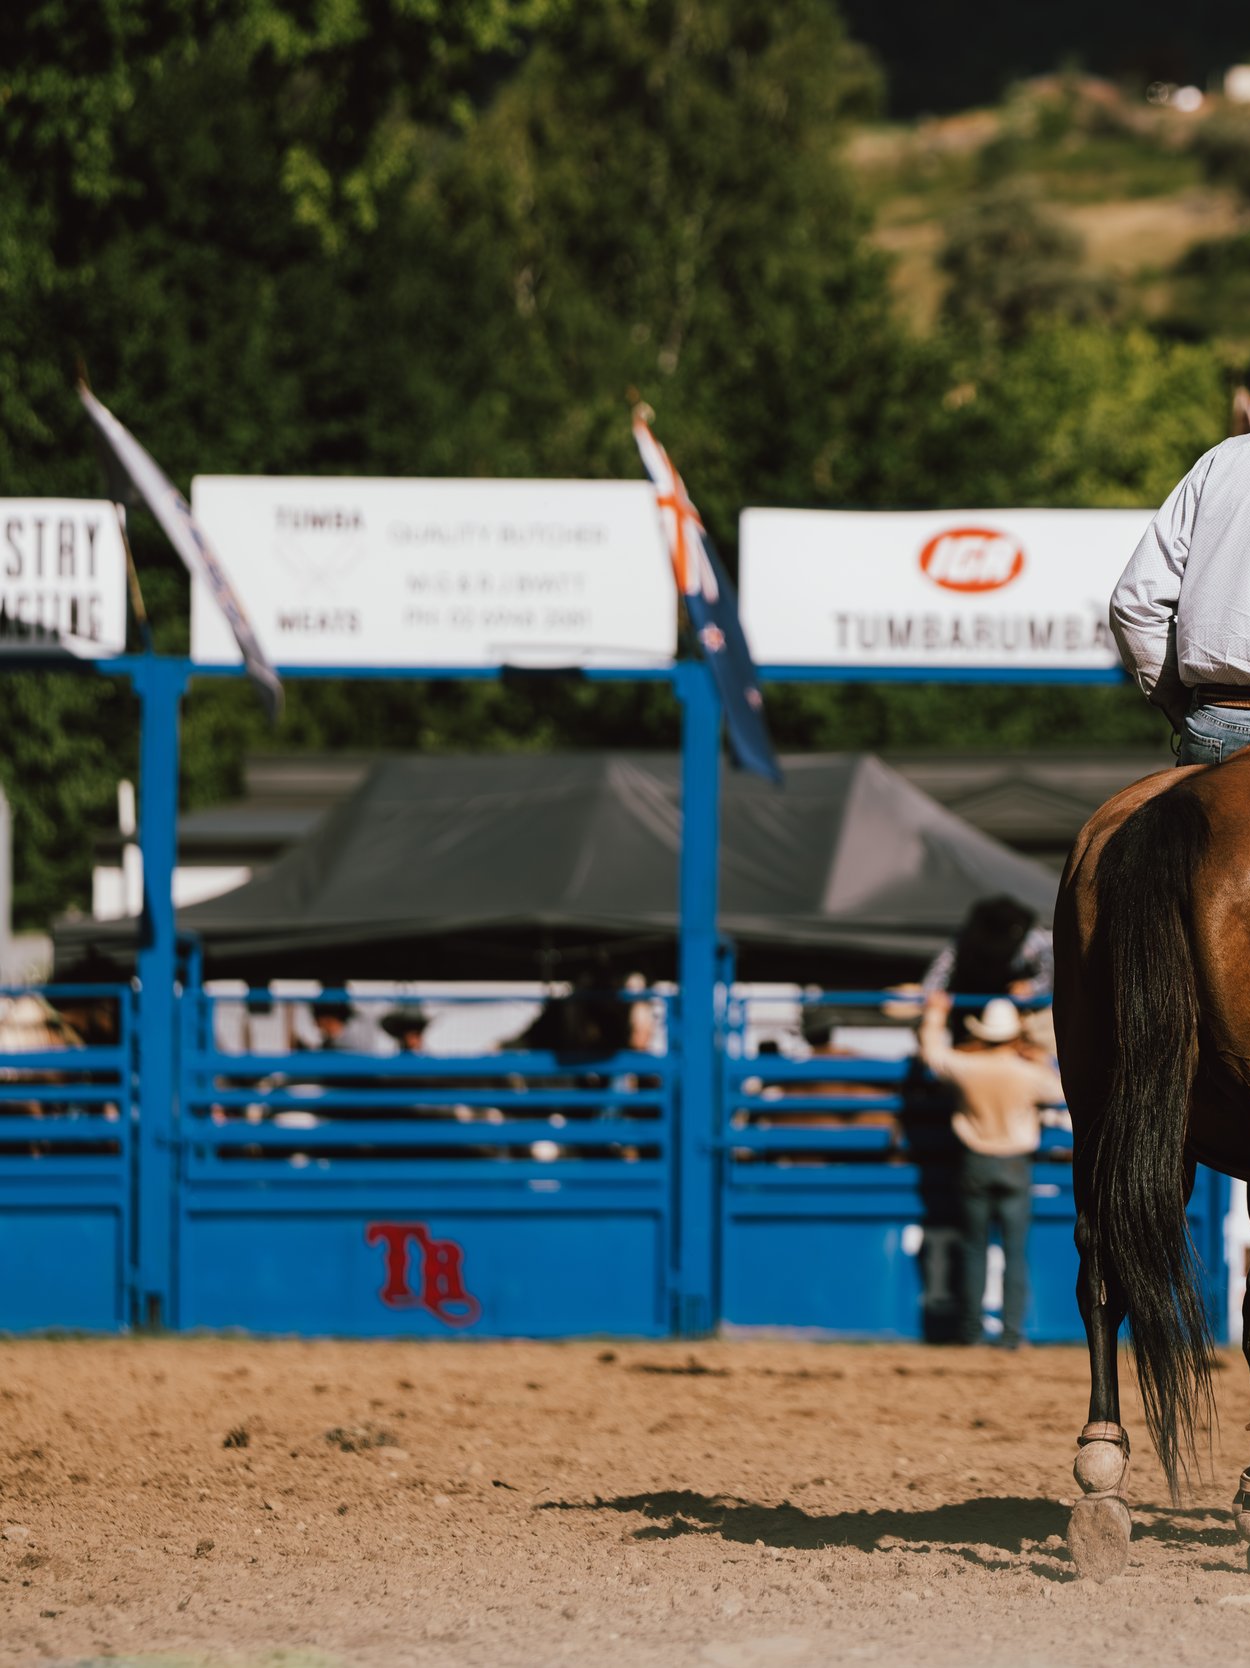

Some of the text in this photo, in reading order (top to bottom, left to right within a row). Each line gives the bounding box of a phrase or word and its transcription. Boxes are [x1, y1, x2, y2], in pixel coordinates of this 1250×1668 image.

[274, 507, 364, 532] TUMBA
[387, 524, 608, 547] QUALITY BUTCHER
[925, 534, 1018, 584] IGA
[276, 608, 362, 634] MEATS
[834, 610, 1112, 651] TUMBARUMBA
